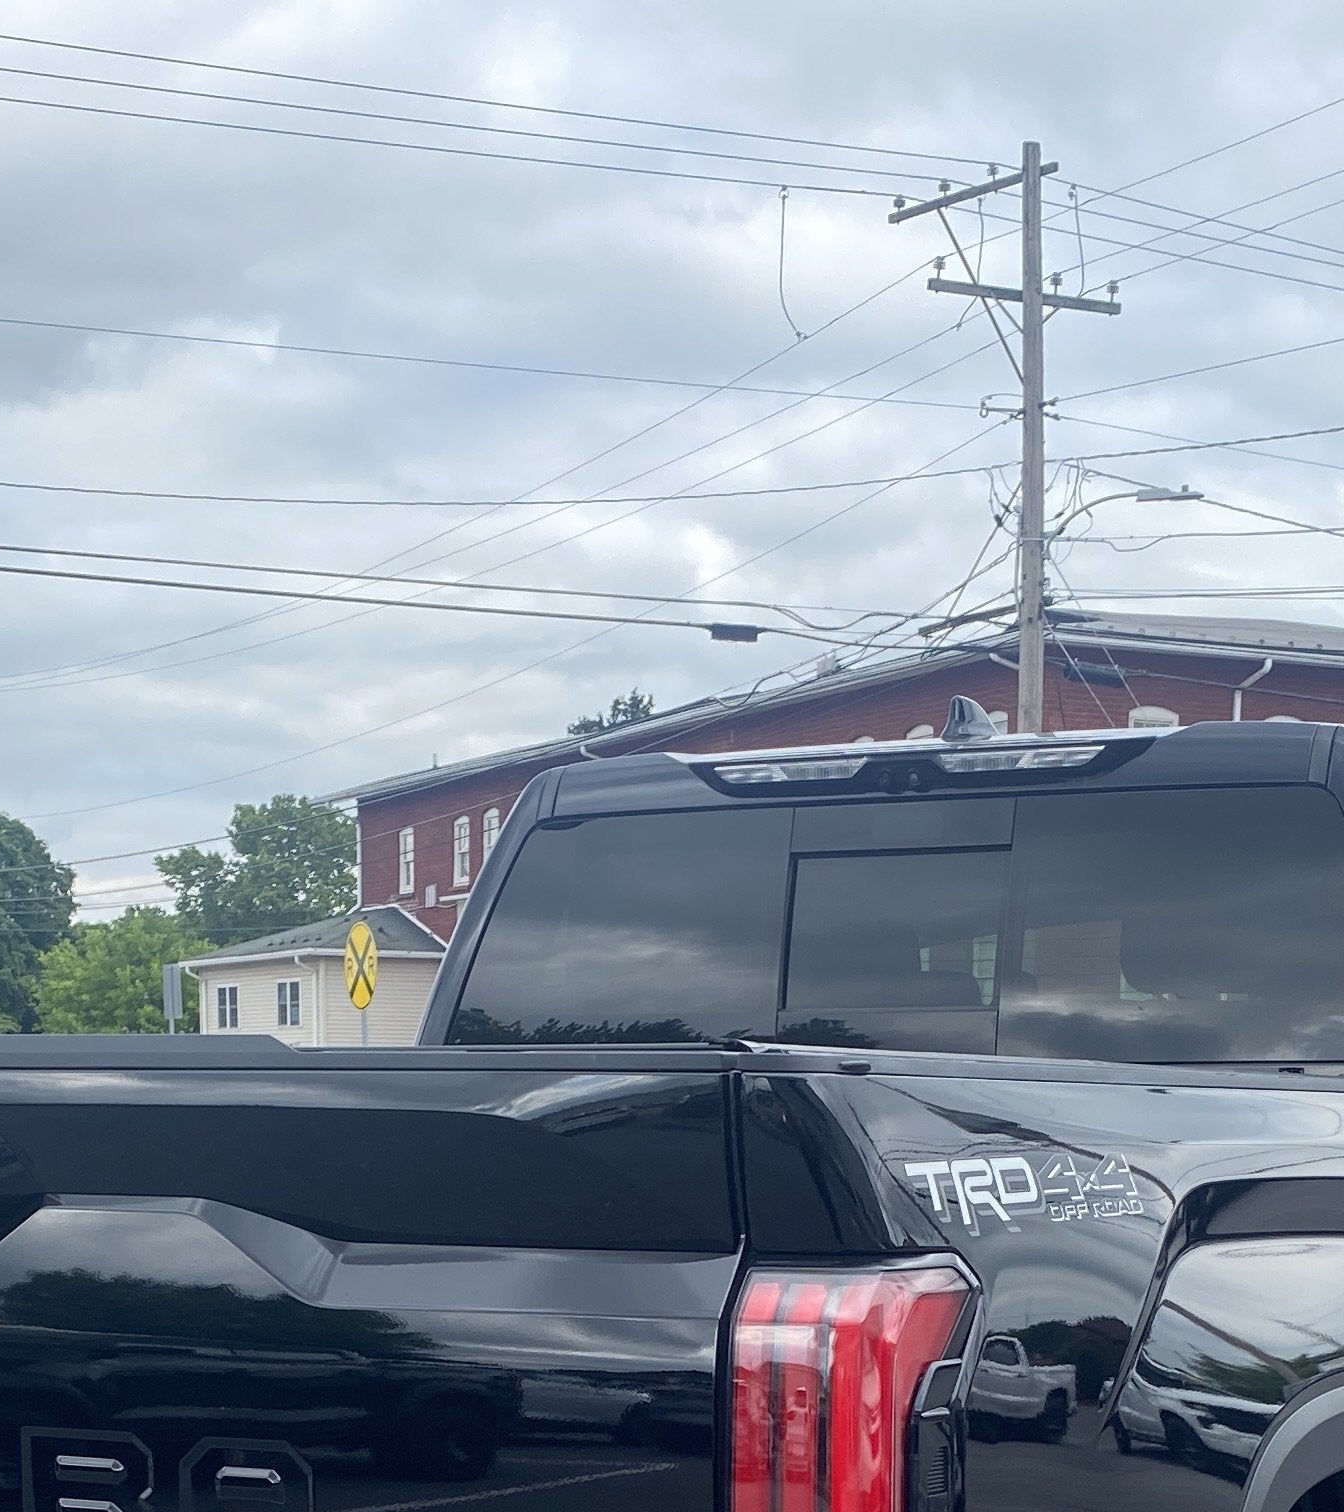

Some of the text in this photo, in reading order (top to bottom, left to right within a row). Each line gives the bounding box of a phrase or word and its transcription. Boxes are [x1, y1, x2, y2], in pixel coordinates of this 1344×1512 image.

[904, 1156, 1044, 1237] TRD
[1050, 1199, 1144, 1222] OFF ROAD
